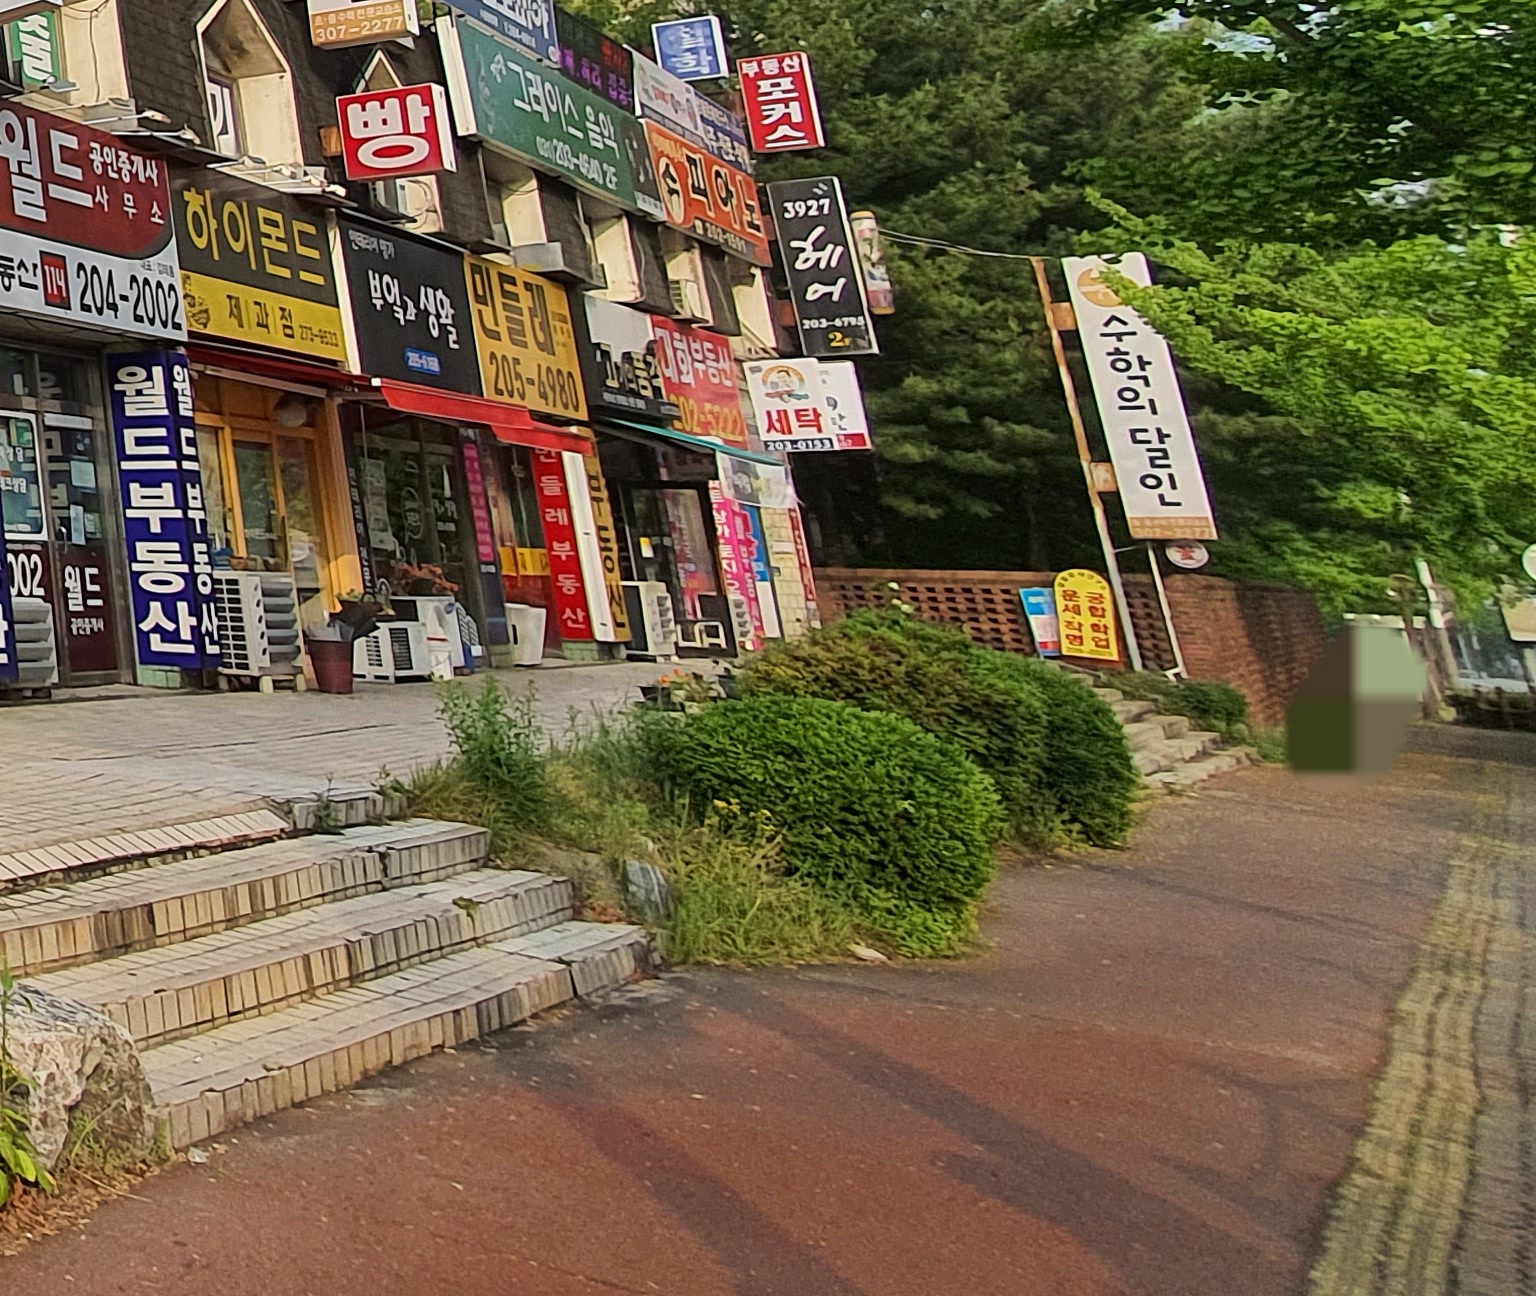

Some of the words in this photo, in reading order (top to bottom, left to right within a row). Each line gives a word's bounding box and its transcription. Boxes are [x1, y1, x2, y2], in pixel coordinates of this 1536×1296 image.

[316, 16, 404, 41] 307-2277
[742, 56, 800, 78] 부동산
[347, 94, 432, 171] 빵
[507, 61, 584, 140] 그레이스
[585, 105, 620, 160] 음악
[756, 77, 809, 147] 포커스
[88, 141, 159, 188] 공인중개사
[183, 188, 326, 285] 하이몬드
[783, 198, 830, 218] 3927
[44, 264, 65, 290] 114
[76, 262, 182, 332] 204-2002
[790, 225, 847, 303] 헤어
[368, 269, 418, 326] 부엌과
[419, 285, 460, 350] 생활
[471, 263, 556, 357] 민들레
[489, 351, 579, 413] 205-4980
[1099, 314, 1159, 416] 수학의
[1130, 427, 1182, 506] 달인
[766, 407, 823, 435] 세탁
[114, 365, 197, 655] 월드부동산
[64, 565, 104, 612] 월드
